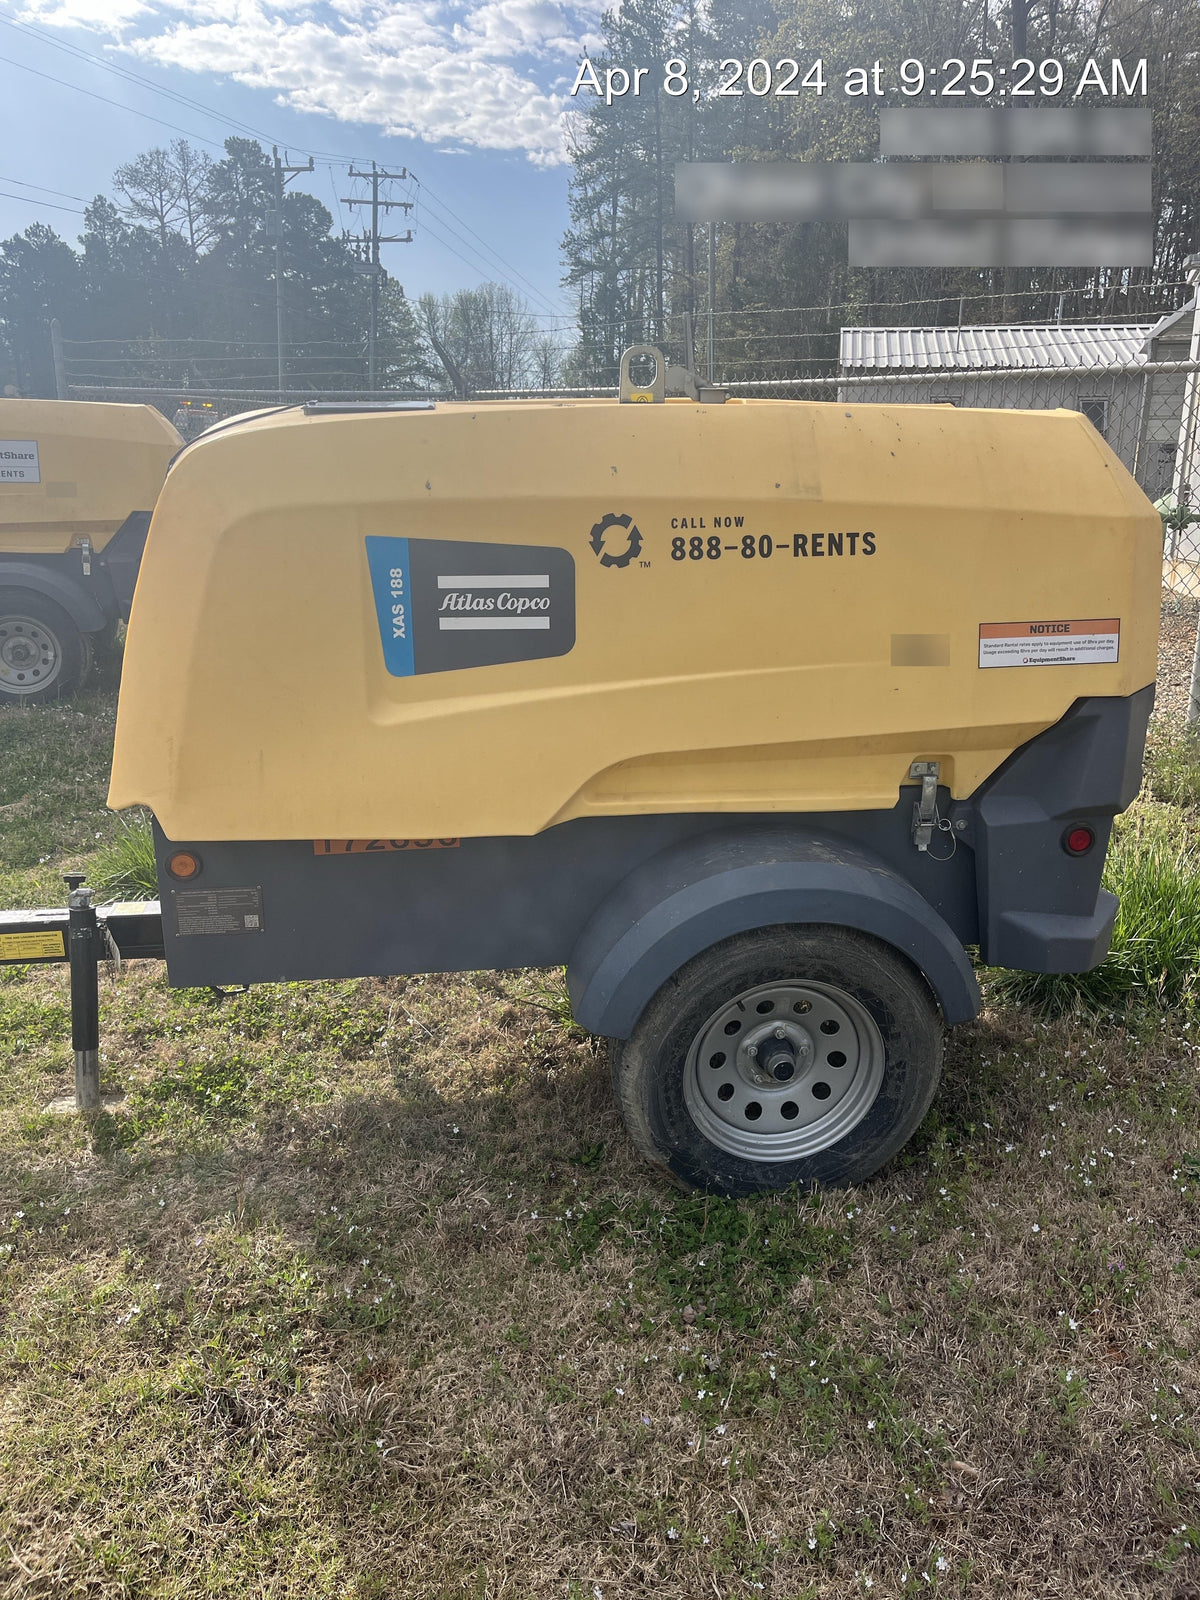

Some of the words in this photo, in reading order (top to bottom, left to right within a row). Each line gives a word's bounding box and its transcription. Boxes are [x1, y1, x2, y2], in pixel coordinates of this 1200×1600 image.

[670, 517, 706, 529] CALL
[713, 516, 745, 528] NOW
[389, 567, 404, 598] 188
[438, 592, 495, 611] Atlas
[497, 592, 551, 614] Copco
[392, 604, 406, 639] XAS
[1029, 624, 1070, 634] NOTICE
